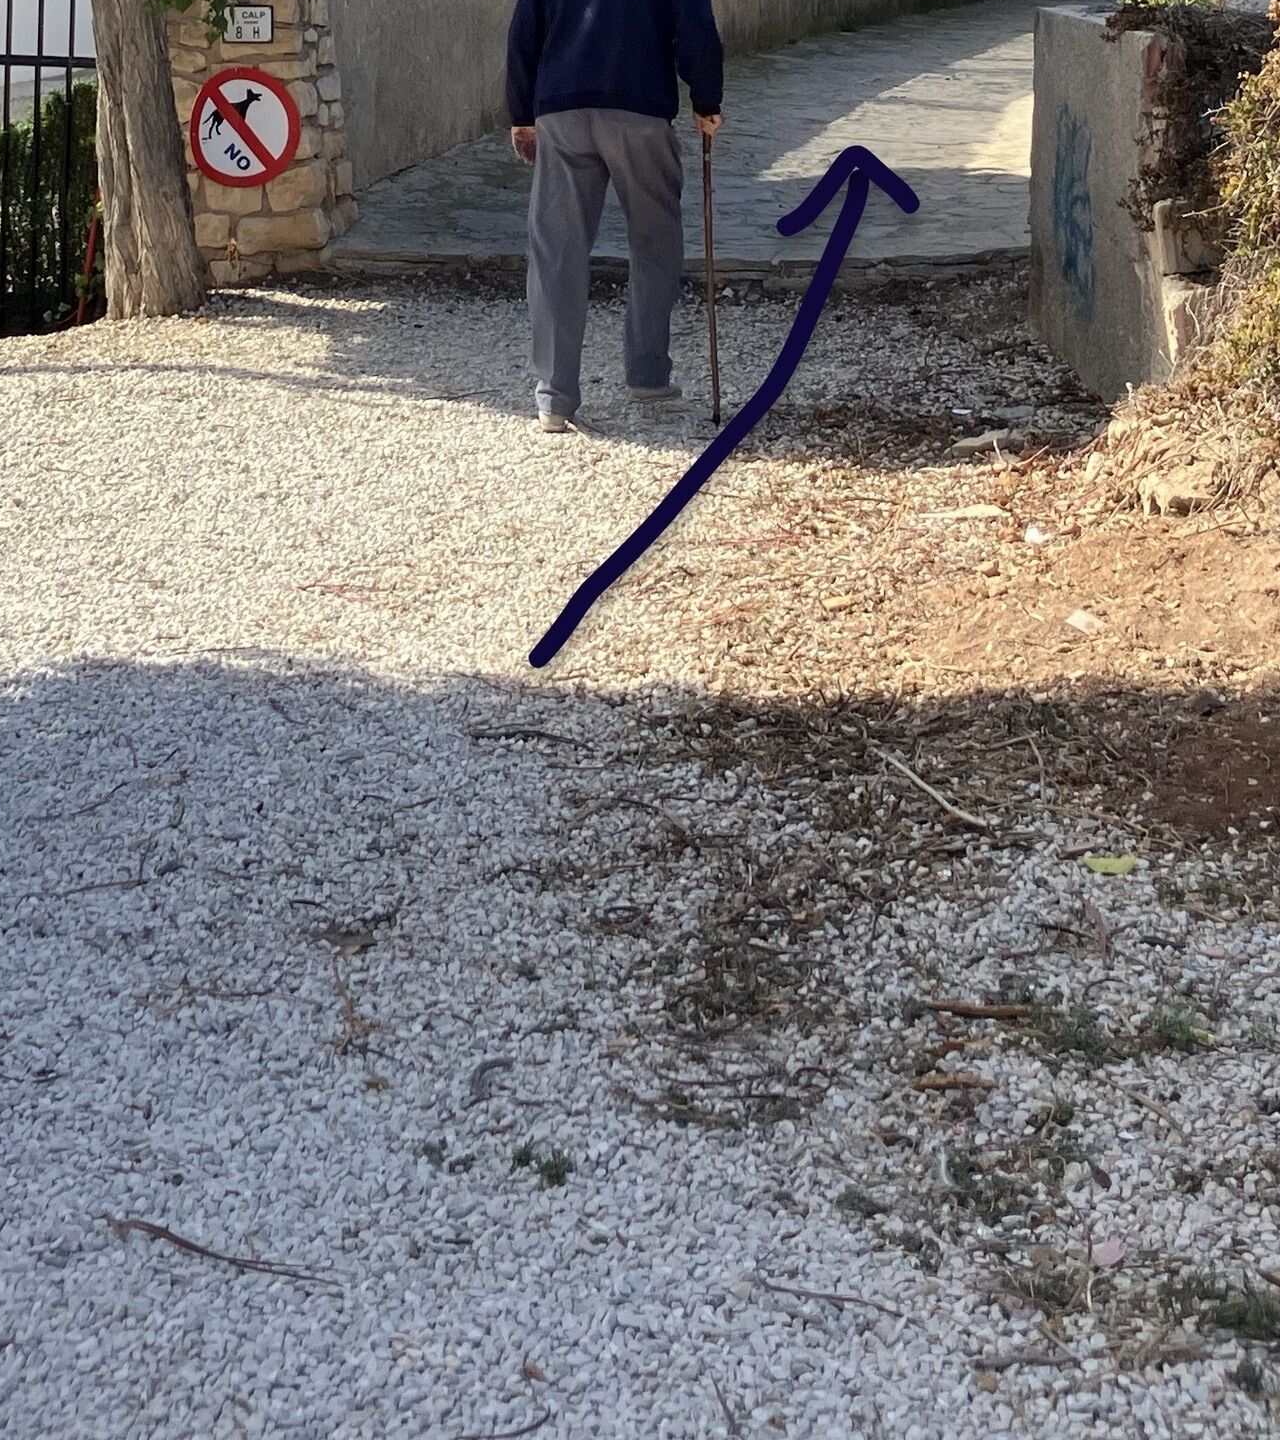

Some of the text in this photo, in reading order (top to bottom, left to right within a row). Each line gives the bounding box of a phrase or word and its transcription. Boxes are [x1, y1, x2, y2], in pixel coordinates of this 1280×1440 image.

[241, 11, 266, 19] CALP
[235, 25, 260, 39] 8 H
[223, 143, 251, 171] NO
